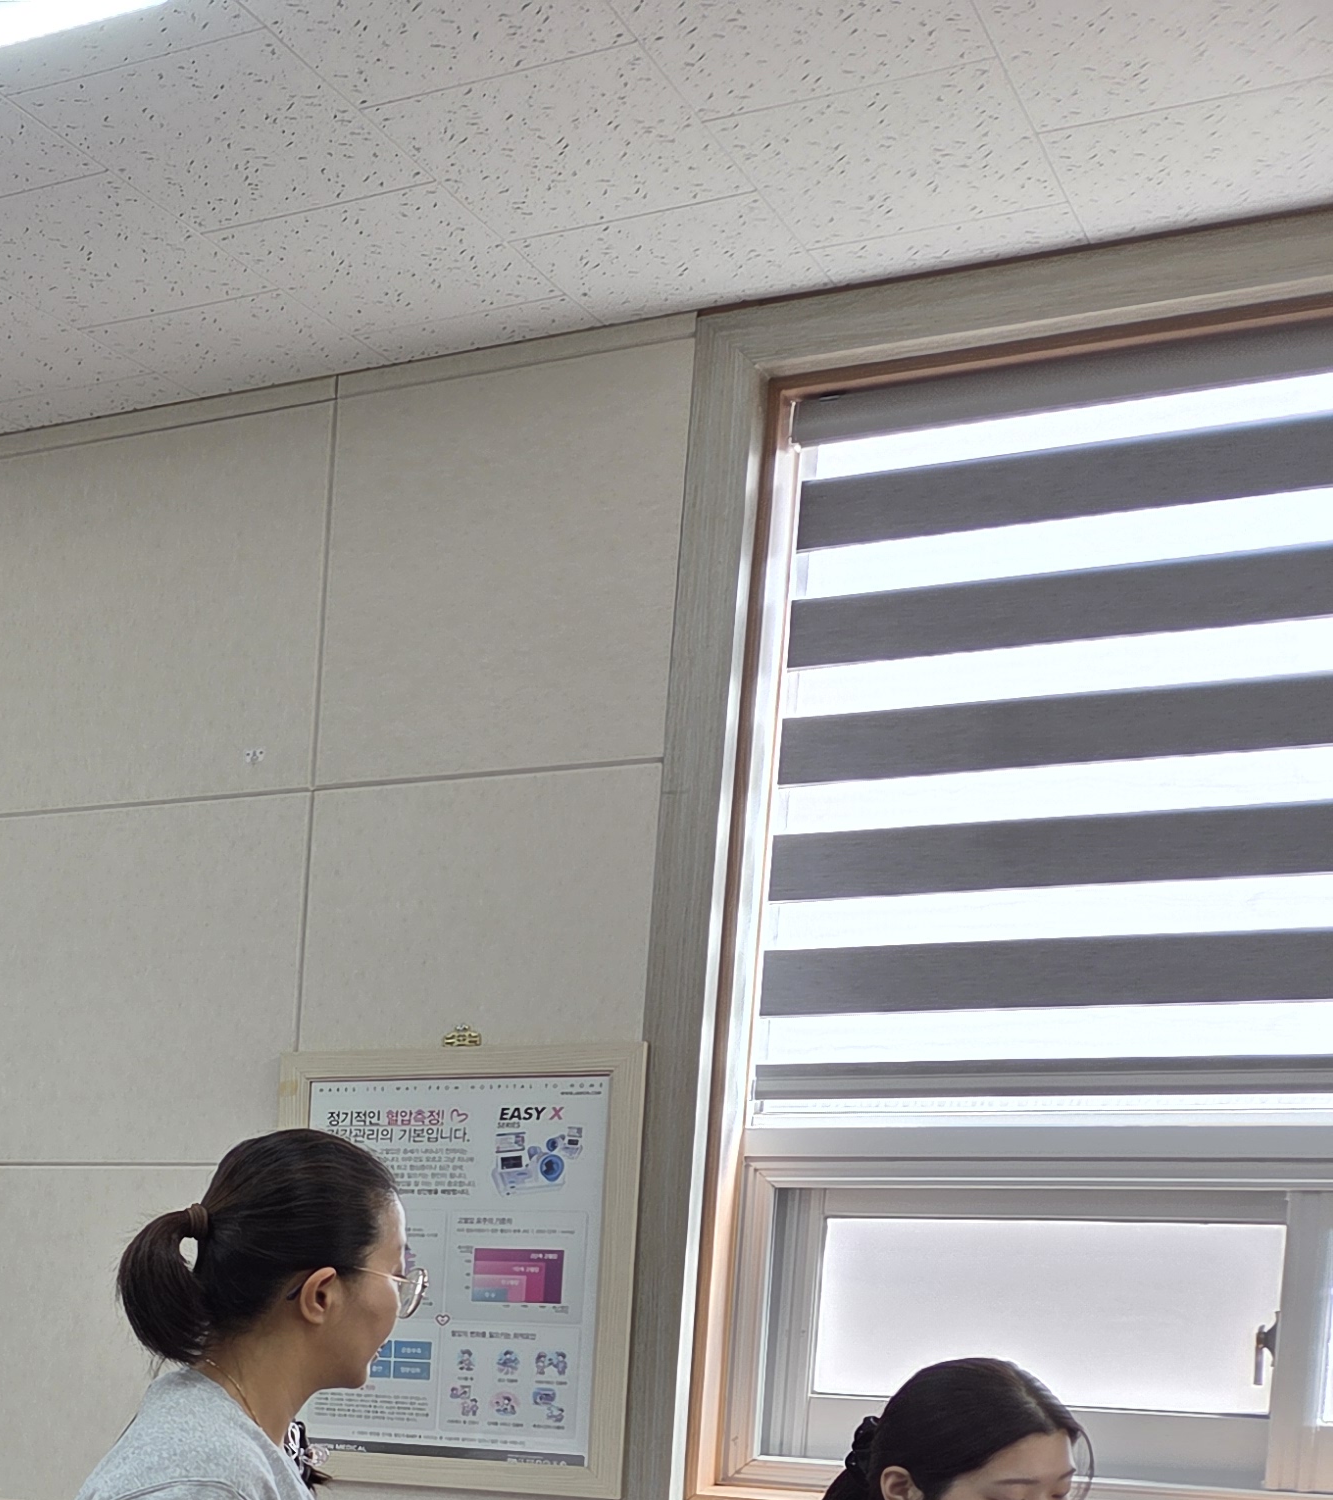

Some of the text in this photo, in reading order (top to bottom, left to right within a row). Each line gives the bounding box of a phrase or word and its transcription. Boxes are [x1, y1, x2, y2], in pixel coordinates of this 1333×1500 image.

[327, 1109, 445, 1126] 정기적인 혈압측정!
[499, 1106, 565, 1121] EASY X
[399, 1127, 470, 1144] 기본입니다.
